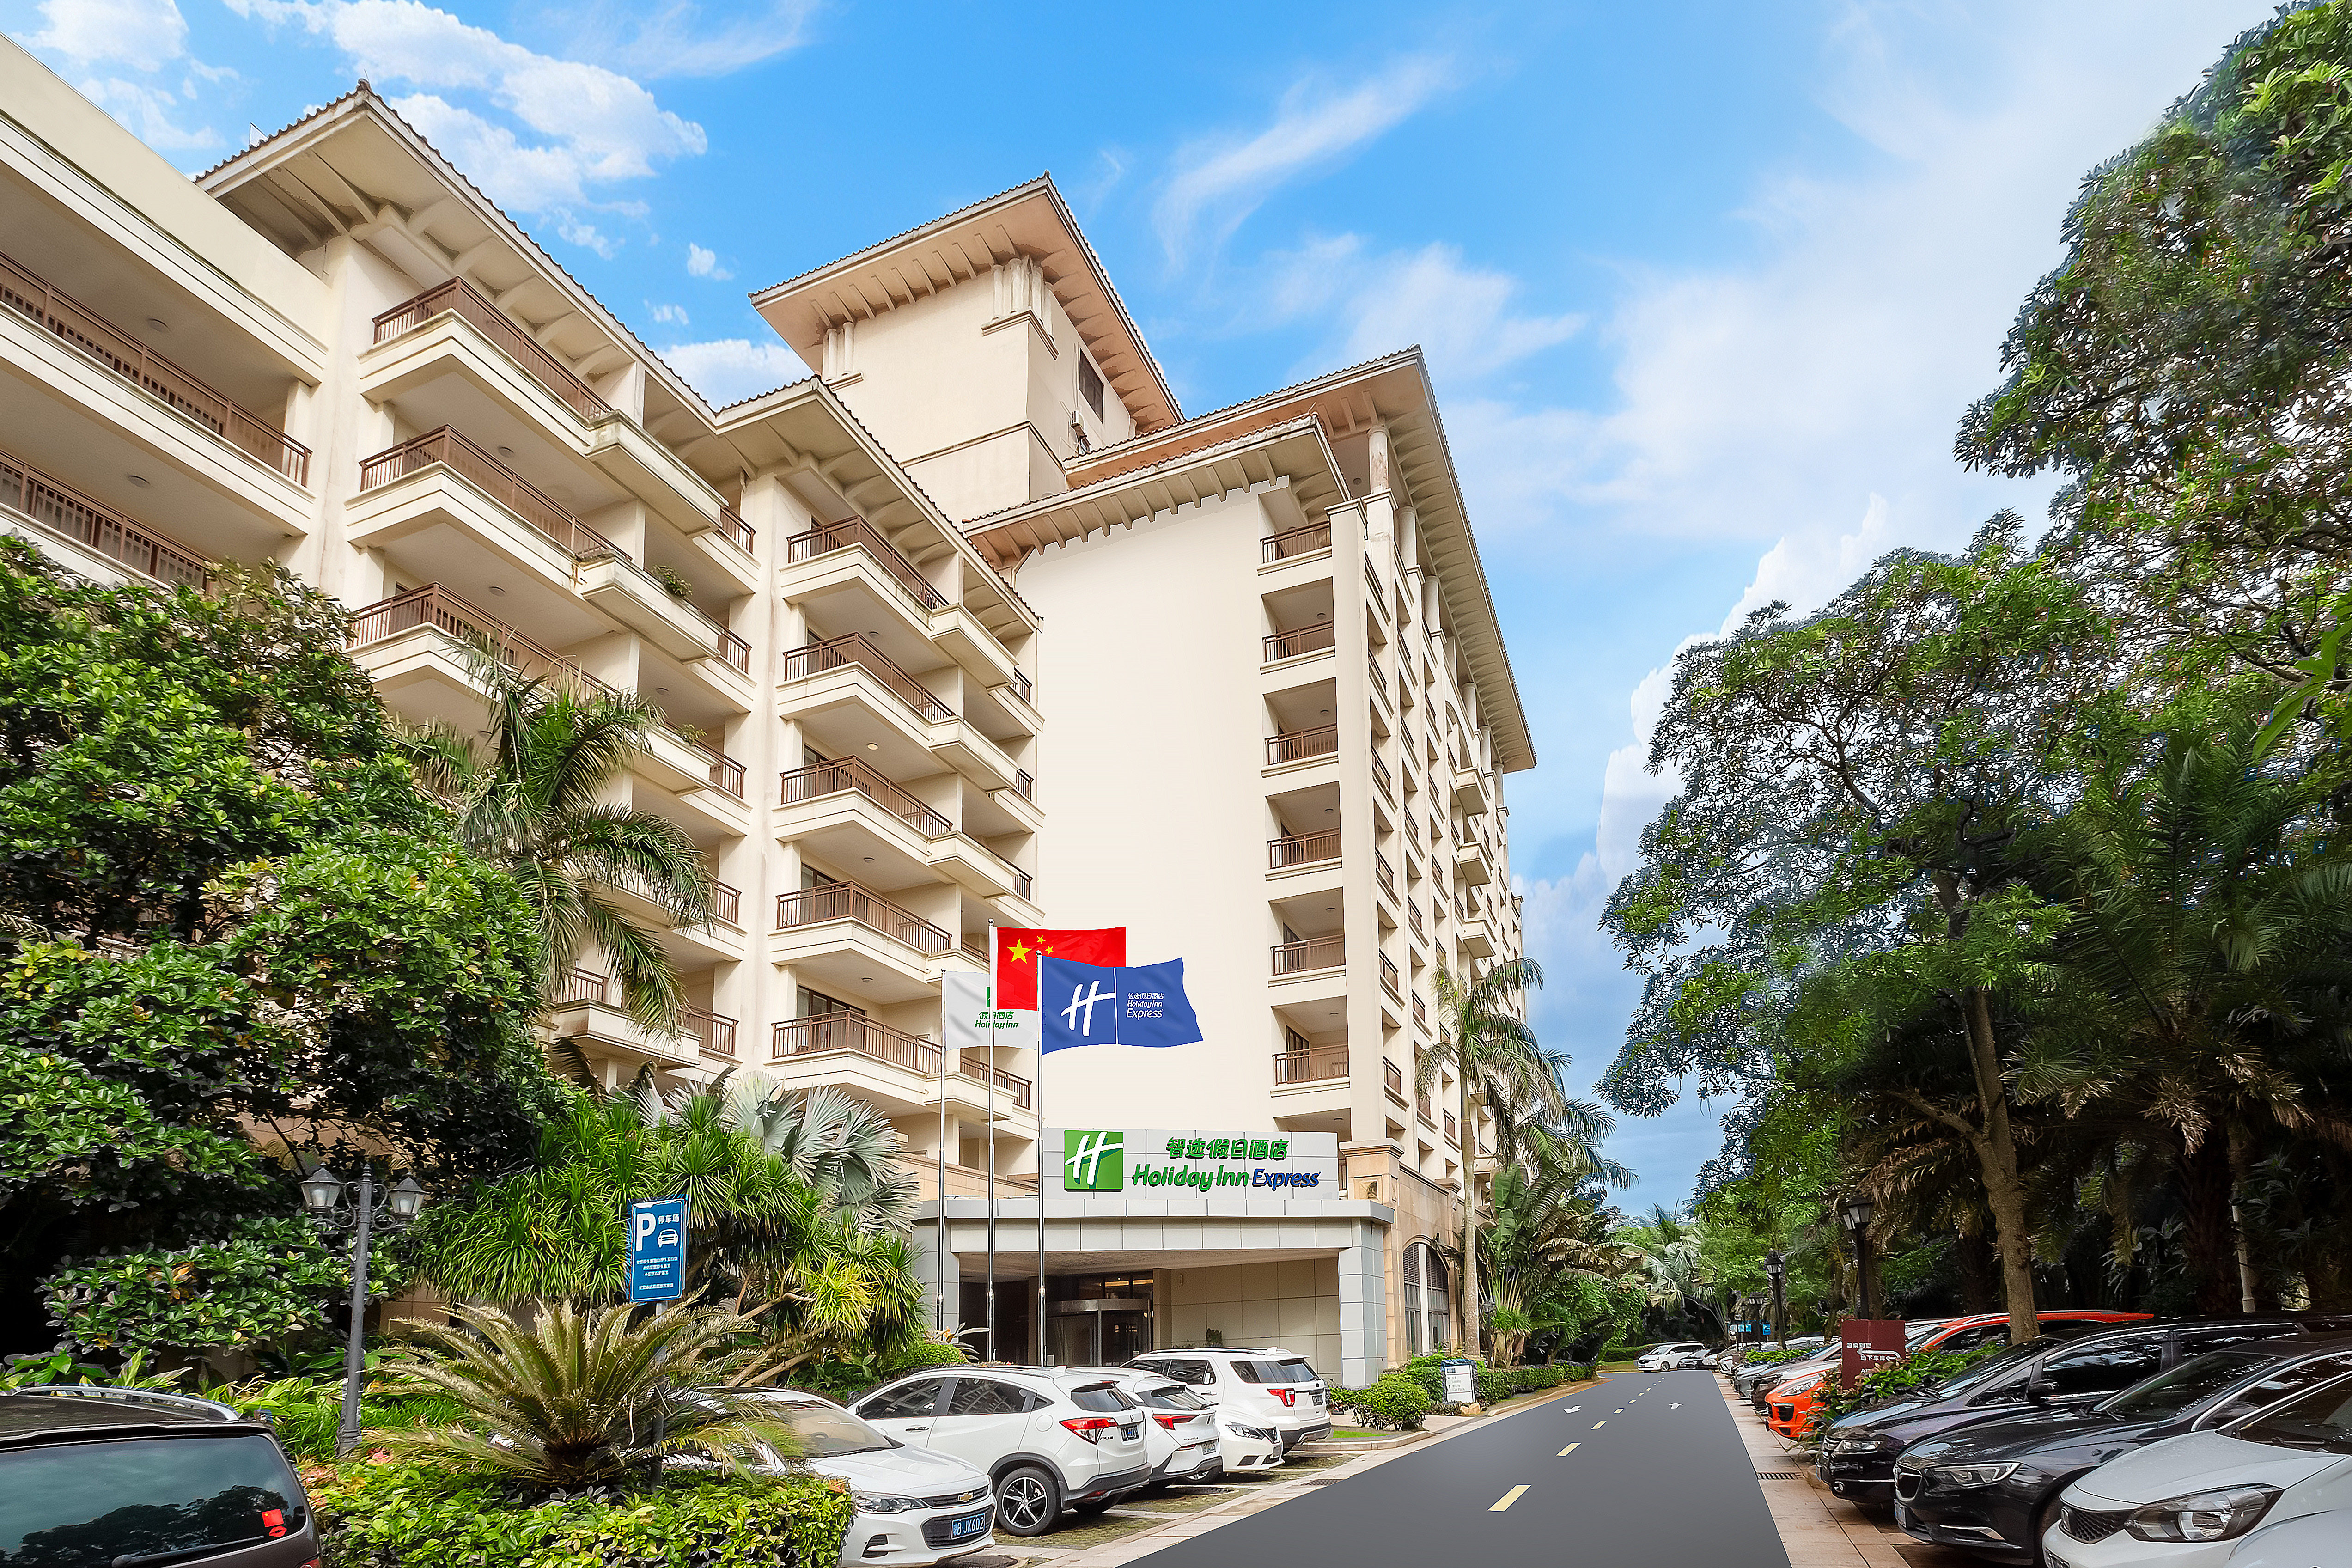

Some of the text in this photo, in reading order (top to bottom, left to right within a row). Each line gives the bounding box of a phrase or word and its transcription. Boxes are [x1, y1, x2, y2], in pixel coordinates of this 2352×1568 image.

[1127, 1000, 1152, 1008] Holiday
[1126, 1008, 1163, 1020] Express
[1006, 1020, 1018, 1028] Inn
[1166, 1136, 1288, 1160] 智选假日酒店
[1132, 1163, 1320, 1192] Holiday Inn Express
[636, 1213, 656, 1251] P
